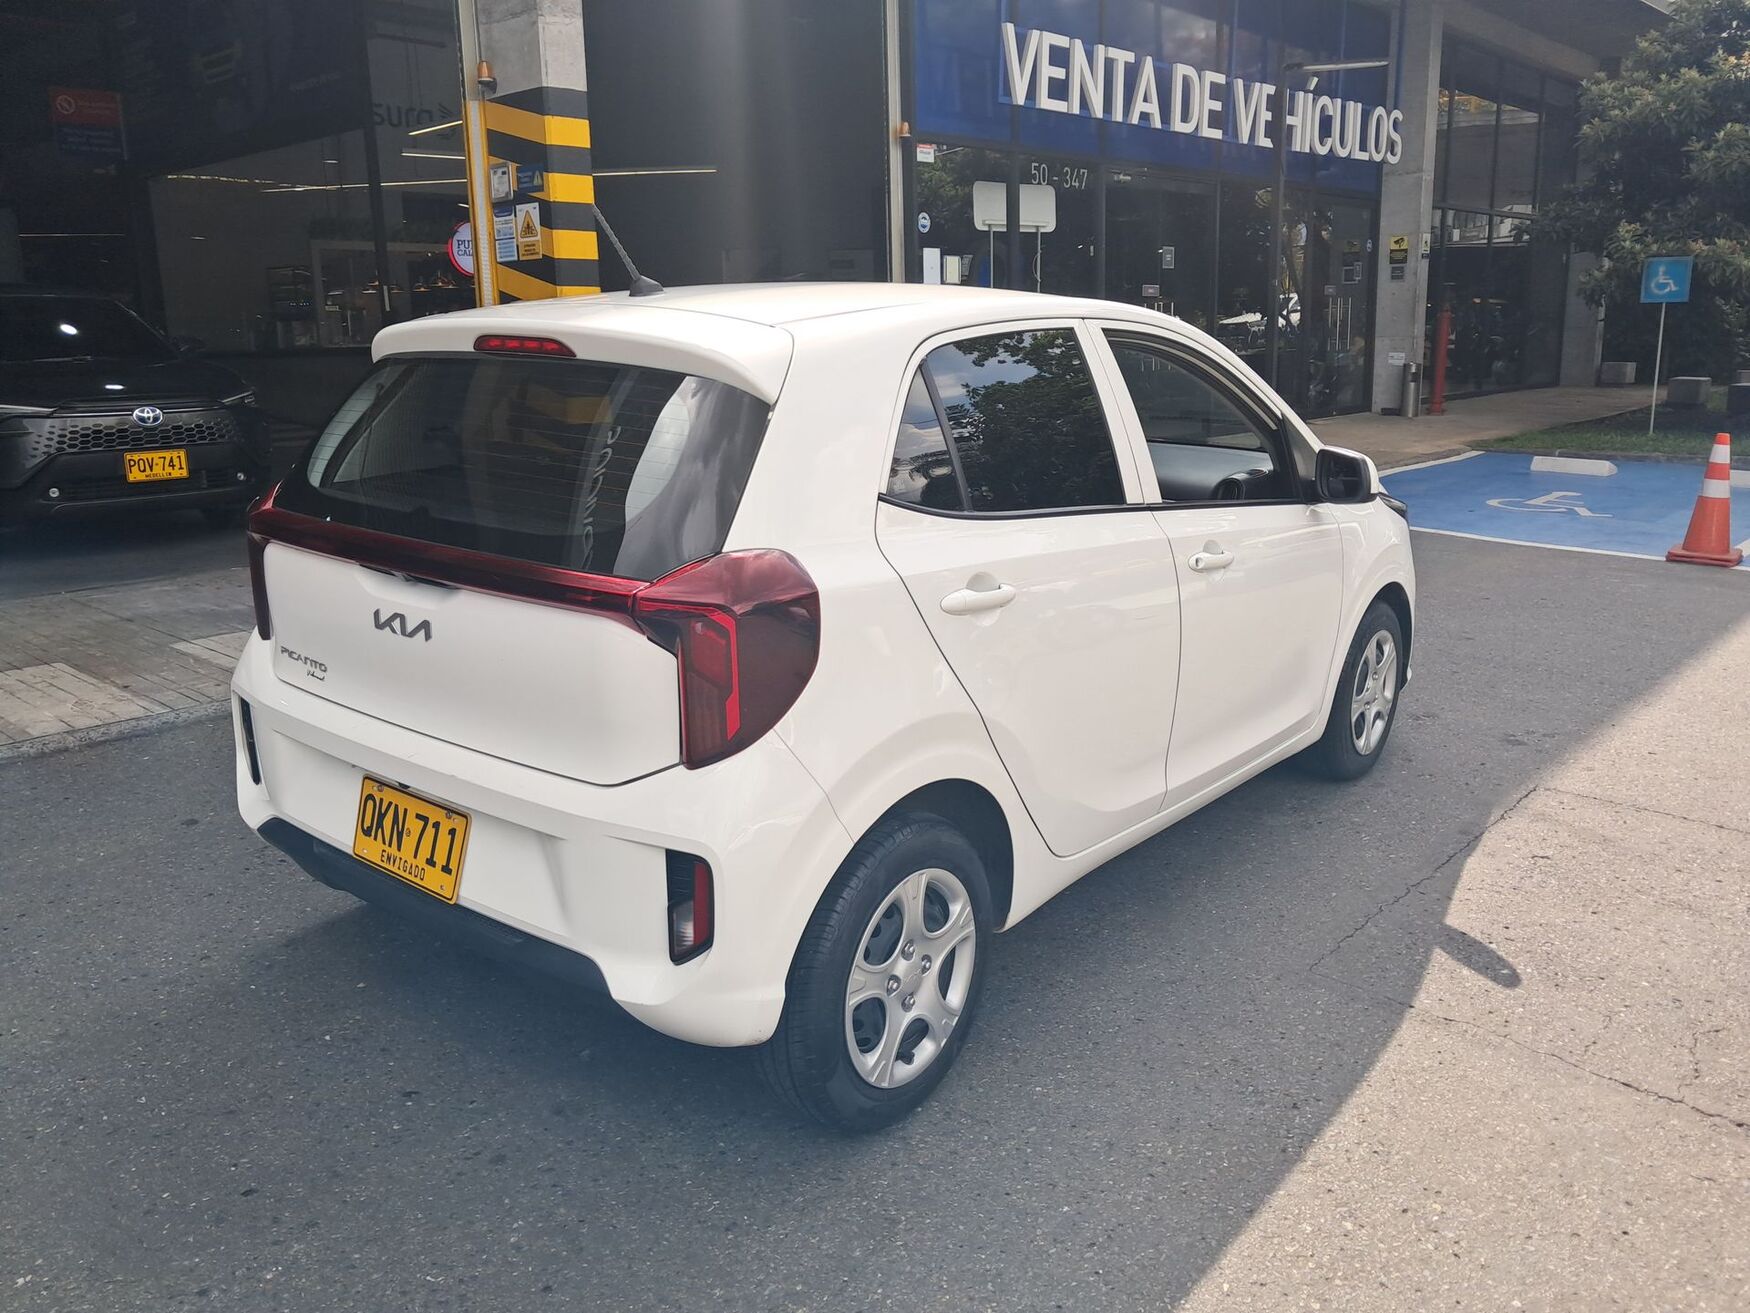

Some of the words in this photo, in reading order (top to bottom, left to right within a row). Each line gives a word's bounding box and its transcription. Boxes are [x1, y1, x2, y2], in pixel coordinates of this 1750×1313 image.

[1001, 22, 1162, 129] VENTA
[1170, 62, 1227, 140] DE
[1031, 162, 1048, 186] 50
[1063, 166, 1088, 190] 347
[457, 239, 473, 250] PU
[373, 608, 432, 642] KIA
[280, 645, 328, 673] PICANTO
[380, 849, 426, 881] ENVIGADO
